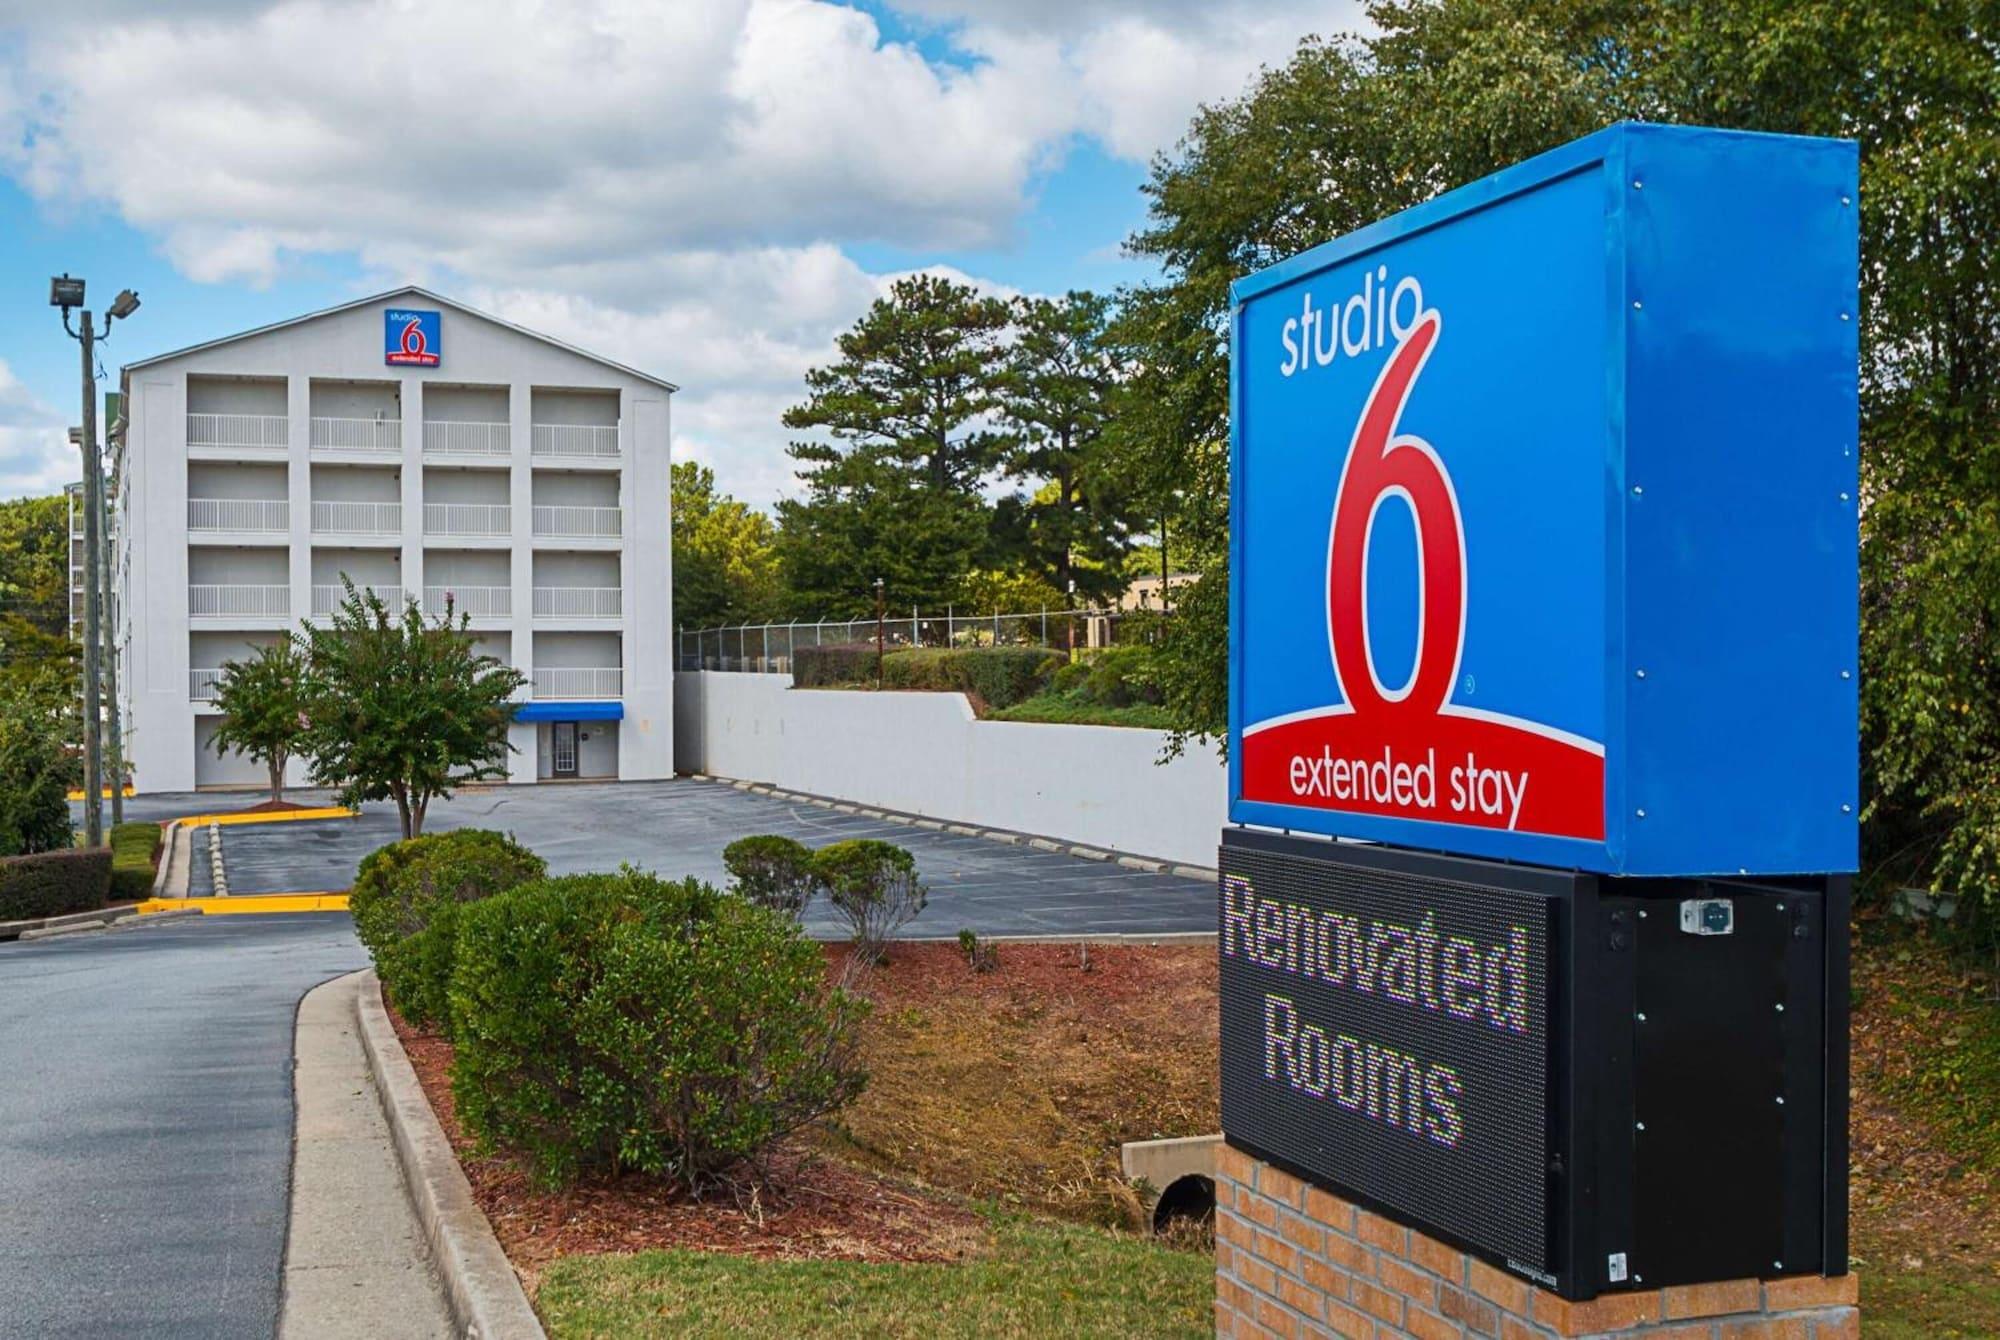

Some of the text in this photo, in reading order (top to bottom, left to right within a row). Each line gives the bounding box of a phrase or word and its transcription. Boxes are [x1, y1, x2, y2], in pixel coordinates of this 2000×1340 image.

[401, 319, 427, 354] 6
[1280, 265, 1422, 377] studio
[1325, 307, 1468, 712] 6
[1290, 745, 1529, 831] extended stay
[1224, 873, 1530, 1034] Renovated
[1264, 993, 1465, 1148] Rooms
